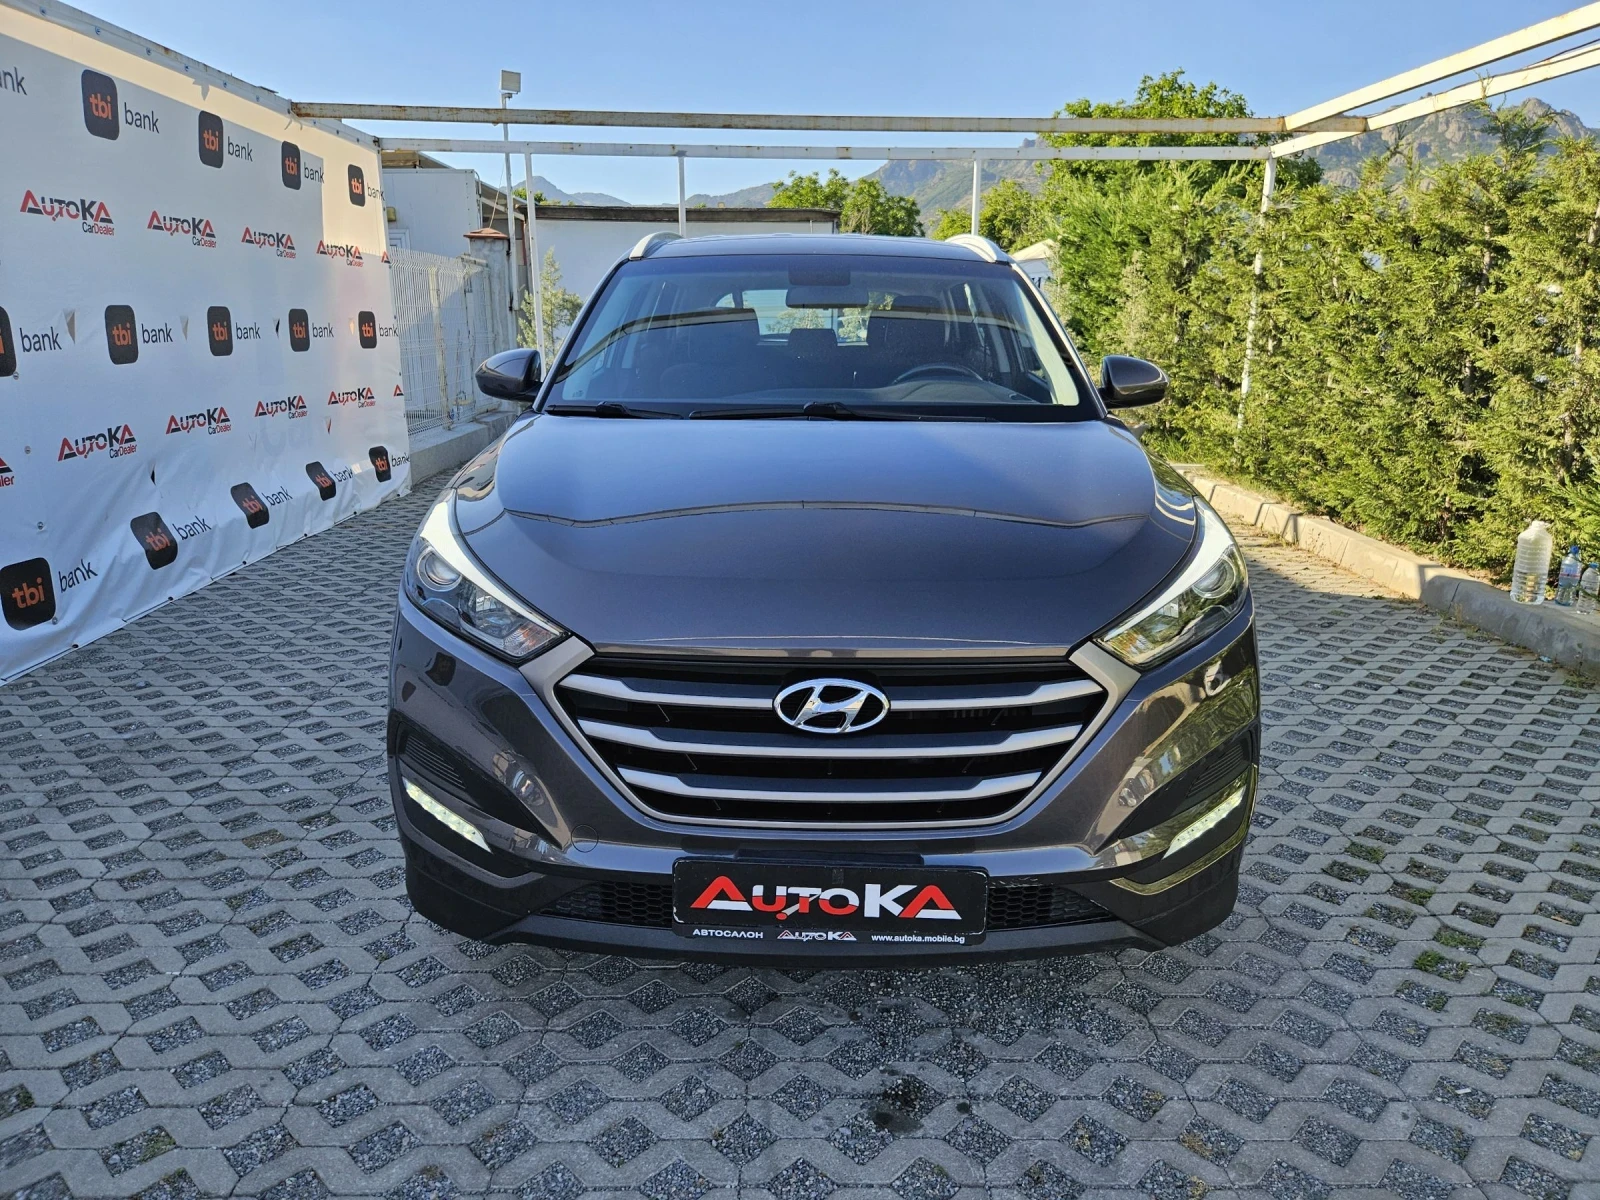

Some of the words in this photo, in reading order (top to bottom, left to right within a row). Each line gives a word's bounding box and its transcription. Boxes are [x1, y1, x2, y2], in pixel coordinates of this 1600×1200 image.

[90, 93, 112, 120] tbi
[124, 102, 160, 134] bank
[203, 129, 219, 152] tbi
[227, 136, 253, 162] bank
[284, 156, 298, 176] tbi
[304, 161, 325, 184] bank
[351, 178, 363, 195] tbi
[367, 181, 386, 201] bank
[82, 221, 115, 236] CarDealer
[192, 236, 217, 249] CarDealer
[112, 322, 132, 346] tbi
[141, 322, 173, 344] bank
[212, 321, 228, 341] tbi
[235, 322, 261, 340] bank
[292, 321, 306, 339] tbi
[312, 322, 335, 339] bank
[362, 322, 374, 337] tbi
[379, 323, 398, 337] bank
[19, 326, 62, 353] bank
[207, 423, 232, 435] CarDealer
[109, 443, 138, 459] CarDealer
[375, 455, 388, 471] tbi
[315, 473, 332, 488] tbi
[242, 495, 264, 515] tbi
[261, 486, 293, 507] bank
[146, 527, 171, 552] tbi
[172, 515, 212, 541] bank
[12, 576, 45, 609] tbi
[58, 558, 98, 594] bank
[692, 928, 764, 939] АВТОСАЛОН
[871, 933, 966, 945] www.autoka.mobile.bg
